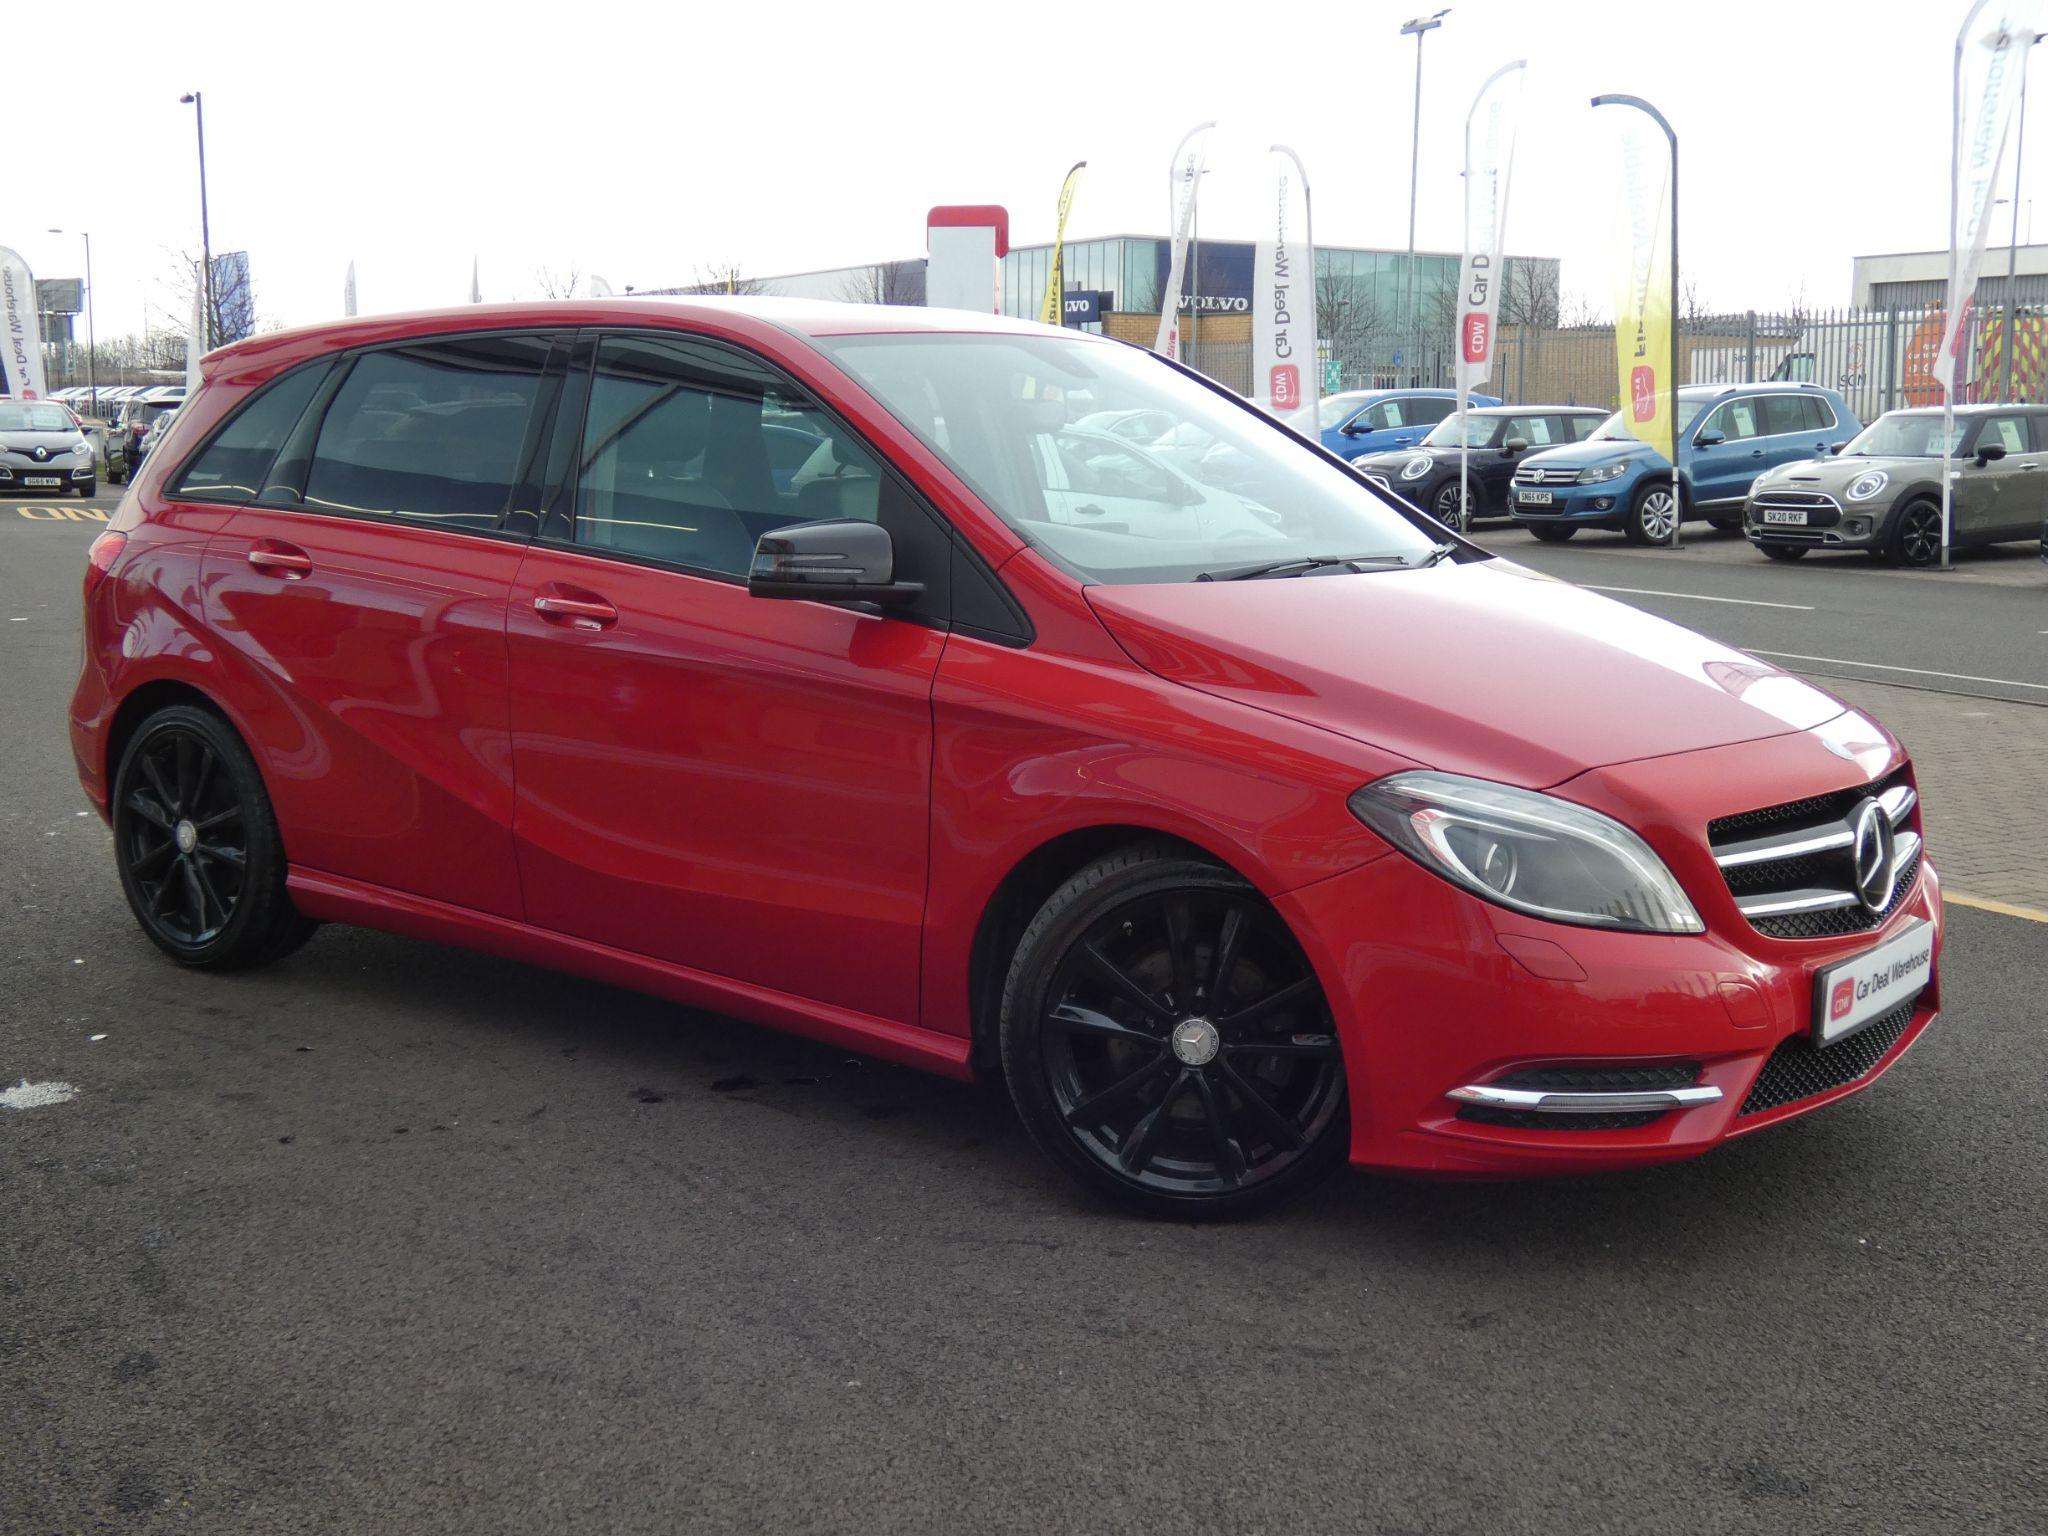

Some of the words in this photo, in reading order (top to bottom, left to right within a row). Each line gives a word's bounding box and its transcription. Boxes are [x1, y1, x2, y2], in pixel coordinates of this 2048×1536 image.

[1468, 274, 1489, 306] Car
[1064, 300, 1090, 313] LVO
[1472, 322, 1486, 353] CDW
[1767, 512, 1787, 522] SK20
[1856, 980, 1872, 1001] Car
[1871, 969, 1890, 993] Deal
[1891, 949, 1930, 981] Warehouse
